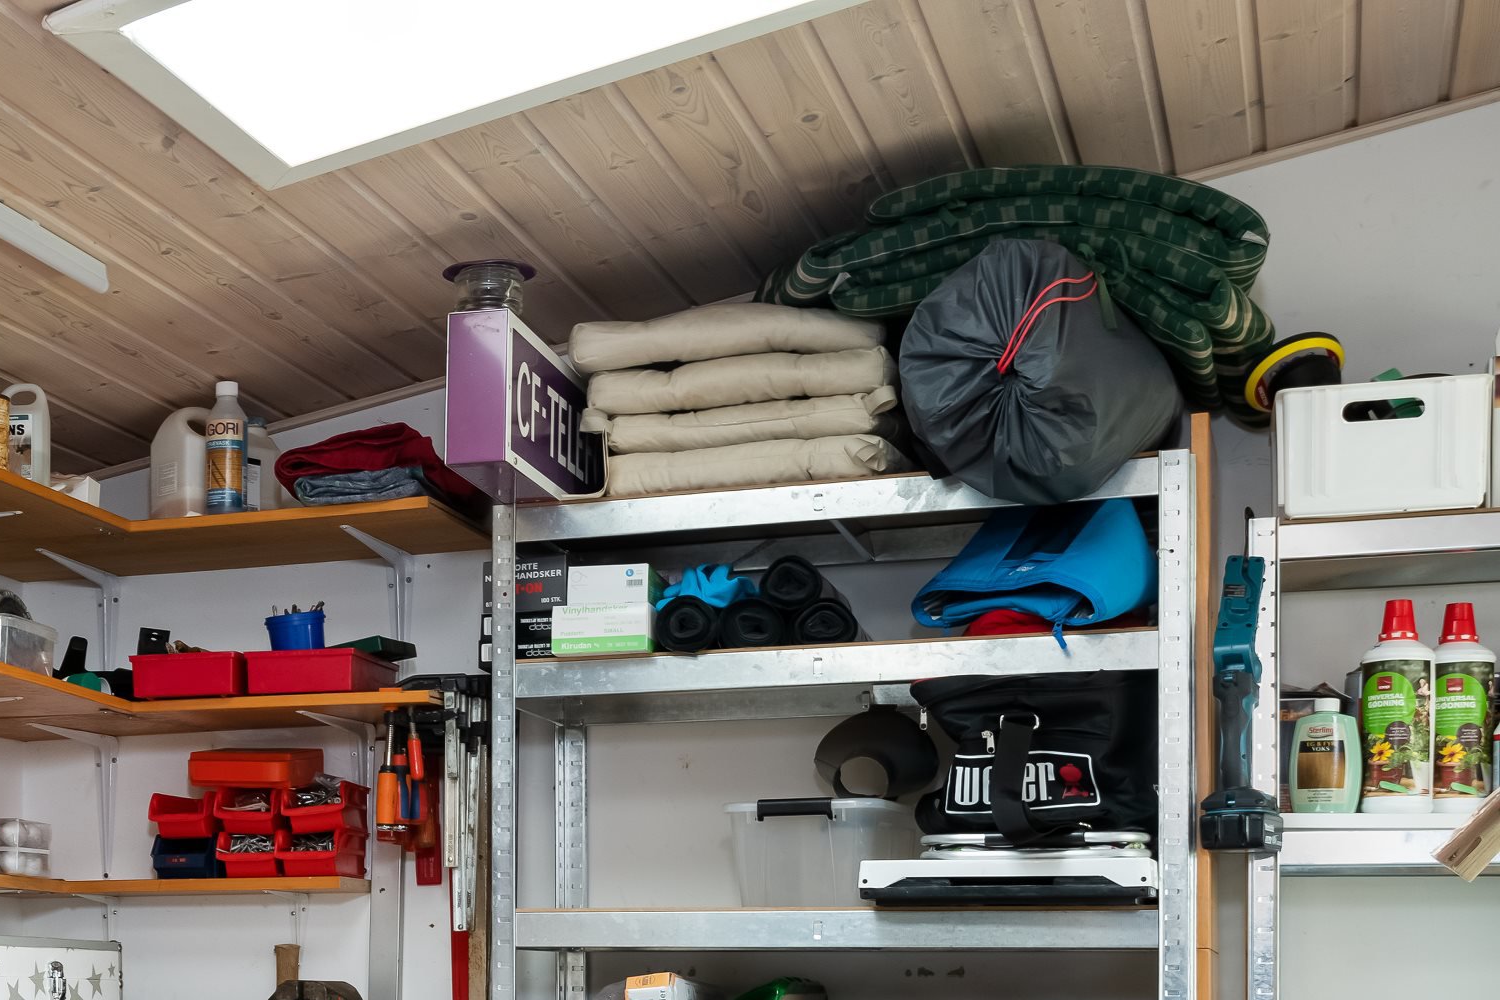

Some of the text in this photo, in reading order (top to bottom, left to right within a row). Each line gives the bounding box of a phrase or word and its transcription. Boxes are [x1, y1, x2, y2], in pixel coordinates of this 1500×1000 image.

[9, 424, 25, 436] NS
[207, 422, 239, 436] GORI
[515, 562, 538, 571] ORTE
